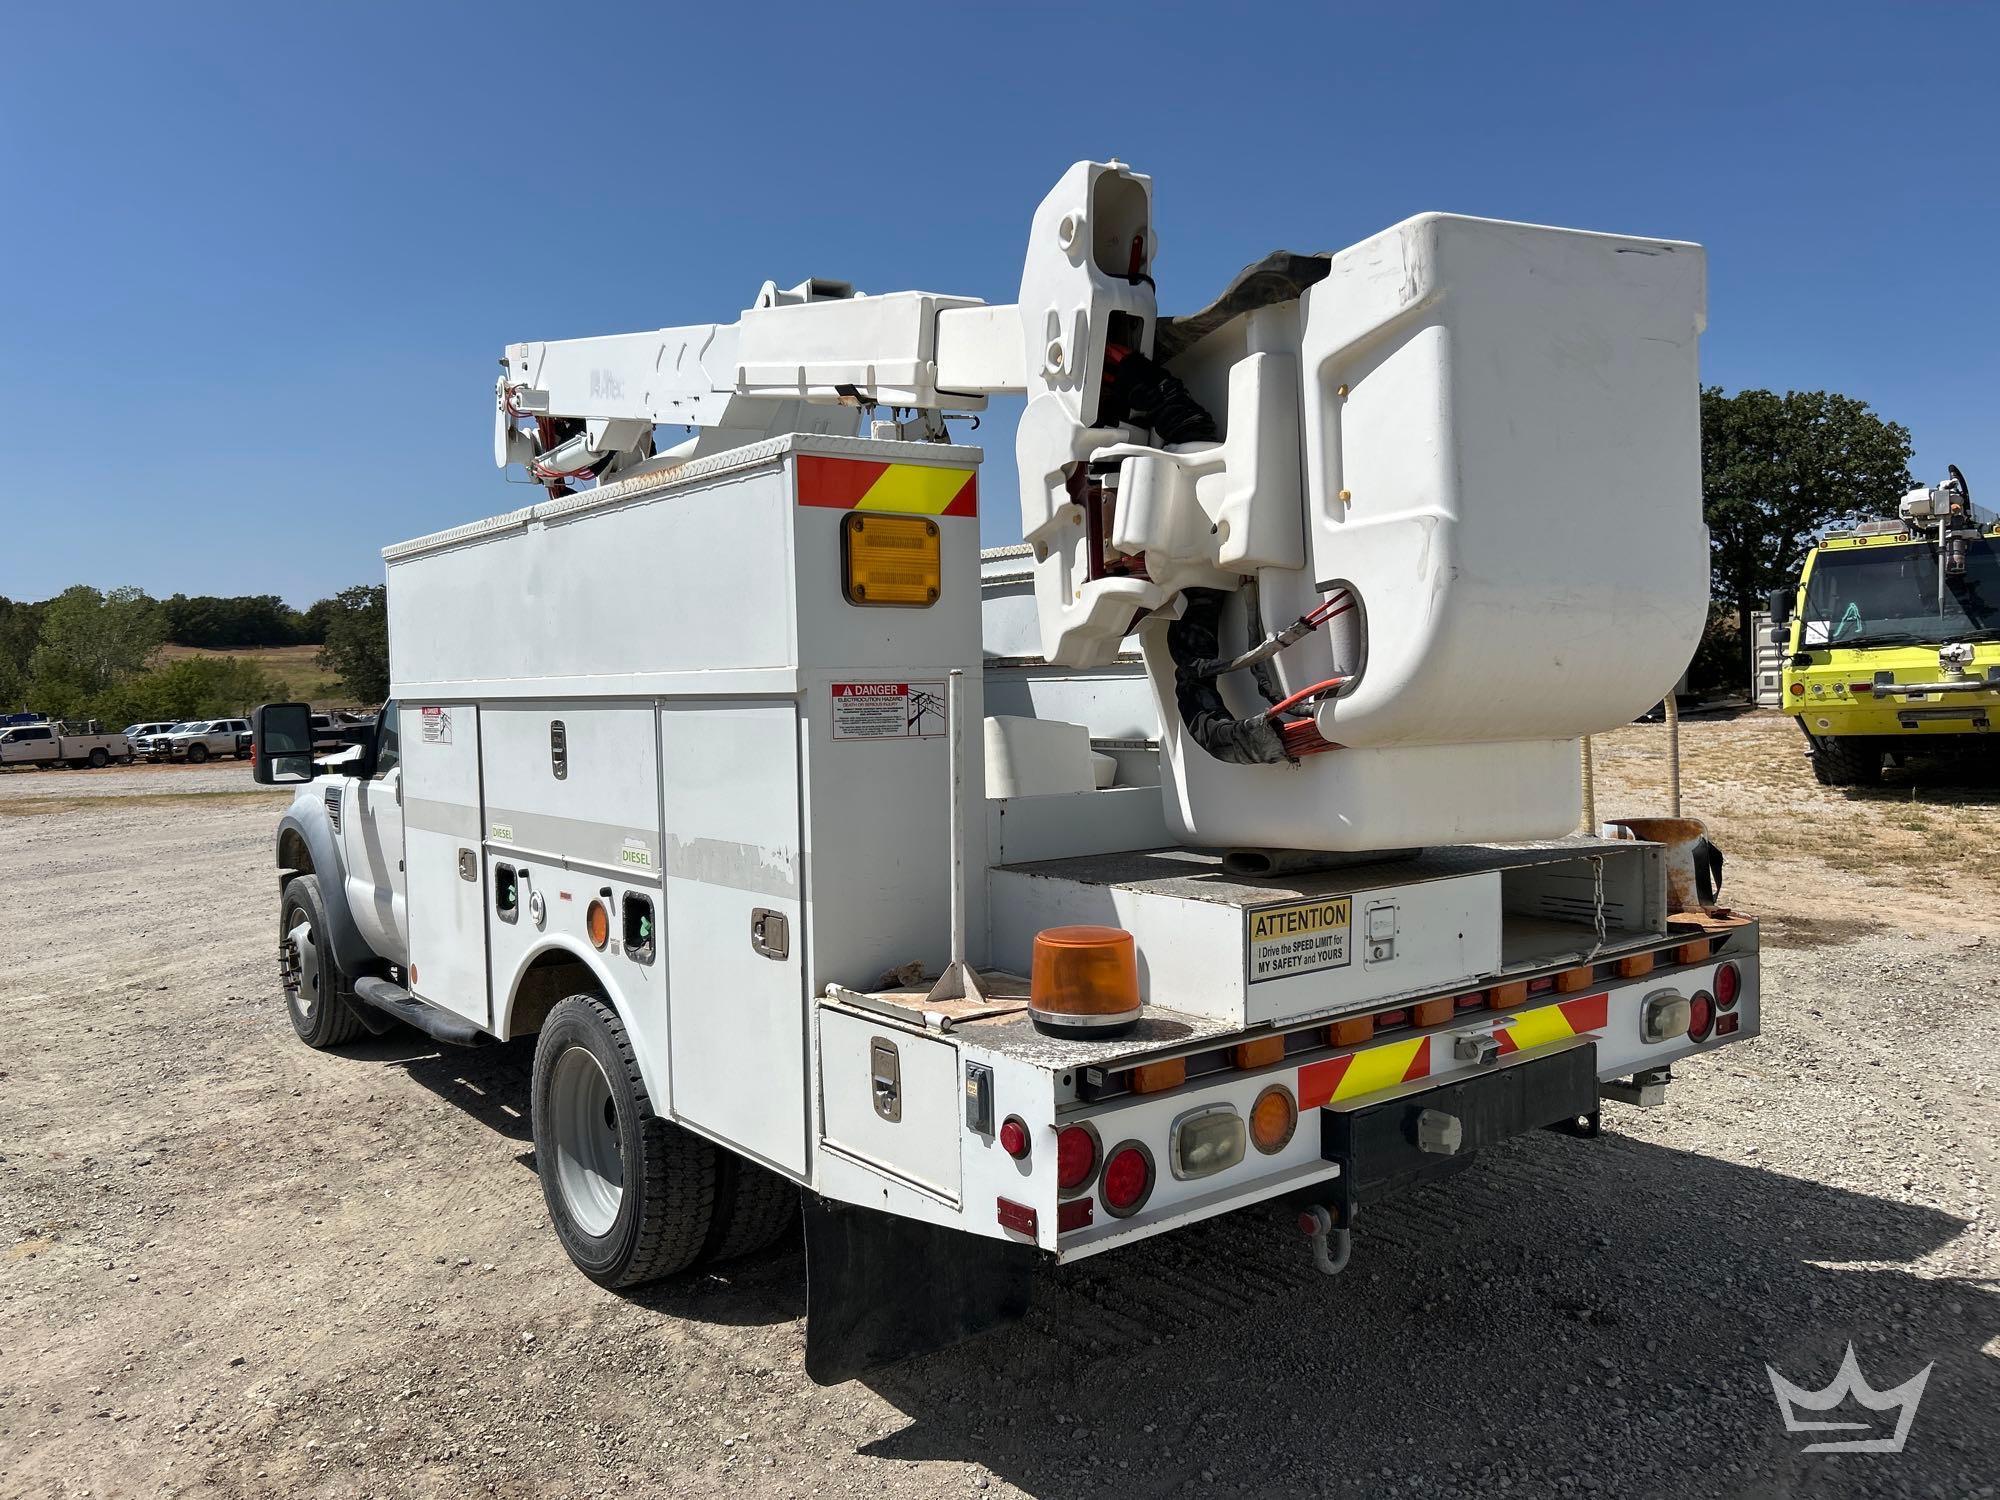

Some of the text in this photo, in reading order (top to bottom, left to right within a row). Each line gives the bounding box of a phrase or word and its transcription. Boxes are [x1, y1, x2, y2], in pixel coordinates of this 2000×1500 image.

[1833, 602, 1863, 638] A
[855, 685, 898, 696] DANGER
[492, 827, 513, 840] DIESEL
[622, 850, 651, 866] DIESEL
[1254, 903, 1346, 938] ATTENTION
[1262, 945, 1280, 958] Drive
[1281, 943, 1291, 955] the
[1292, 939, 1314, 952] SPEED
[1315, 936, 1333, 949] LIMIT
[1333, 935, 1343, 945] for
[1258, 948, 1343, 974] MY SAFETY and YOURS
